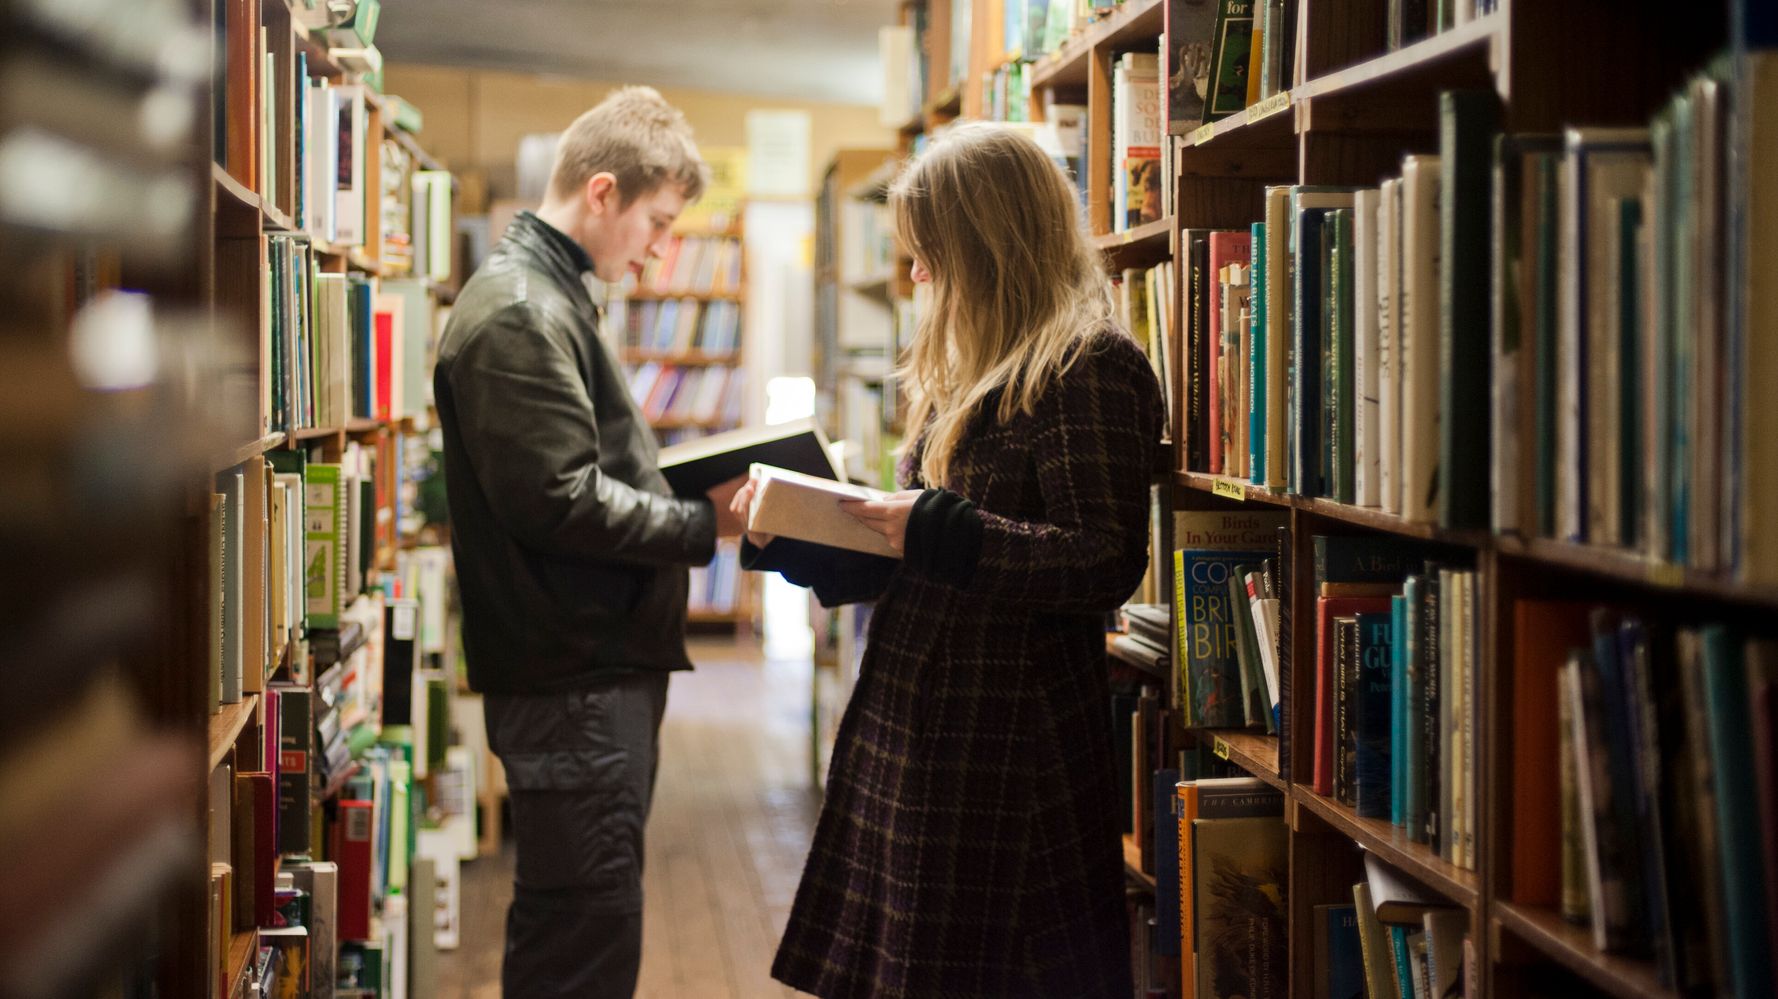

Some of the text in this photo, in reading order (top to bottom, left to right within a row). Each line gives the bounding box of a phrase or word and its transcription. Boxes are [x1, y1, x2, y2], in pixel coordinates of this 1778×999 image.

[1226, 0, 1248, 15] for
[1250, 236, 1258, 266] BIRD
[1250, 268, 1258, 328] HABITATS
[1221, 516, 1260, 529] Birds
[1186, 531, 1201, 544] In
[1205, 531, 1240, 545] Your
[1202, 798, 1227, 807] THE
